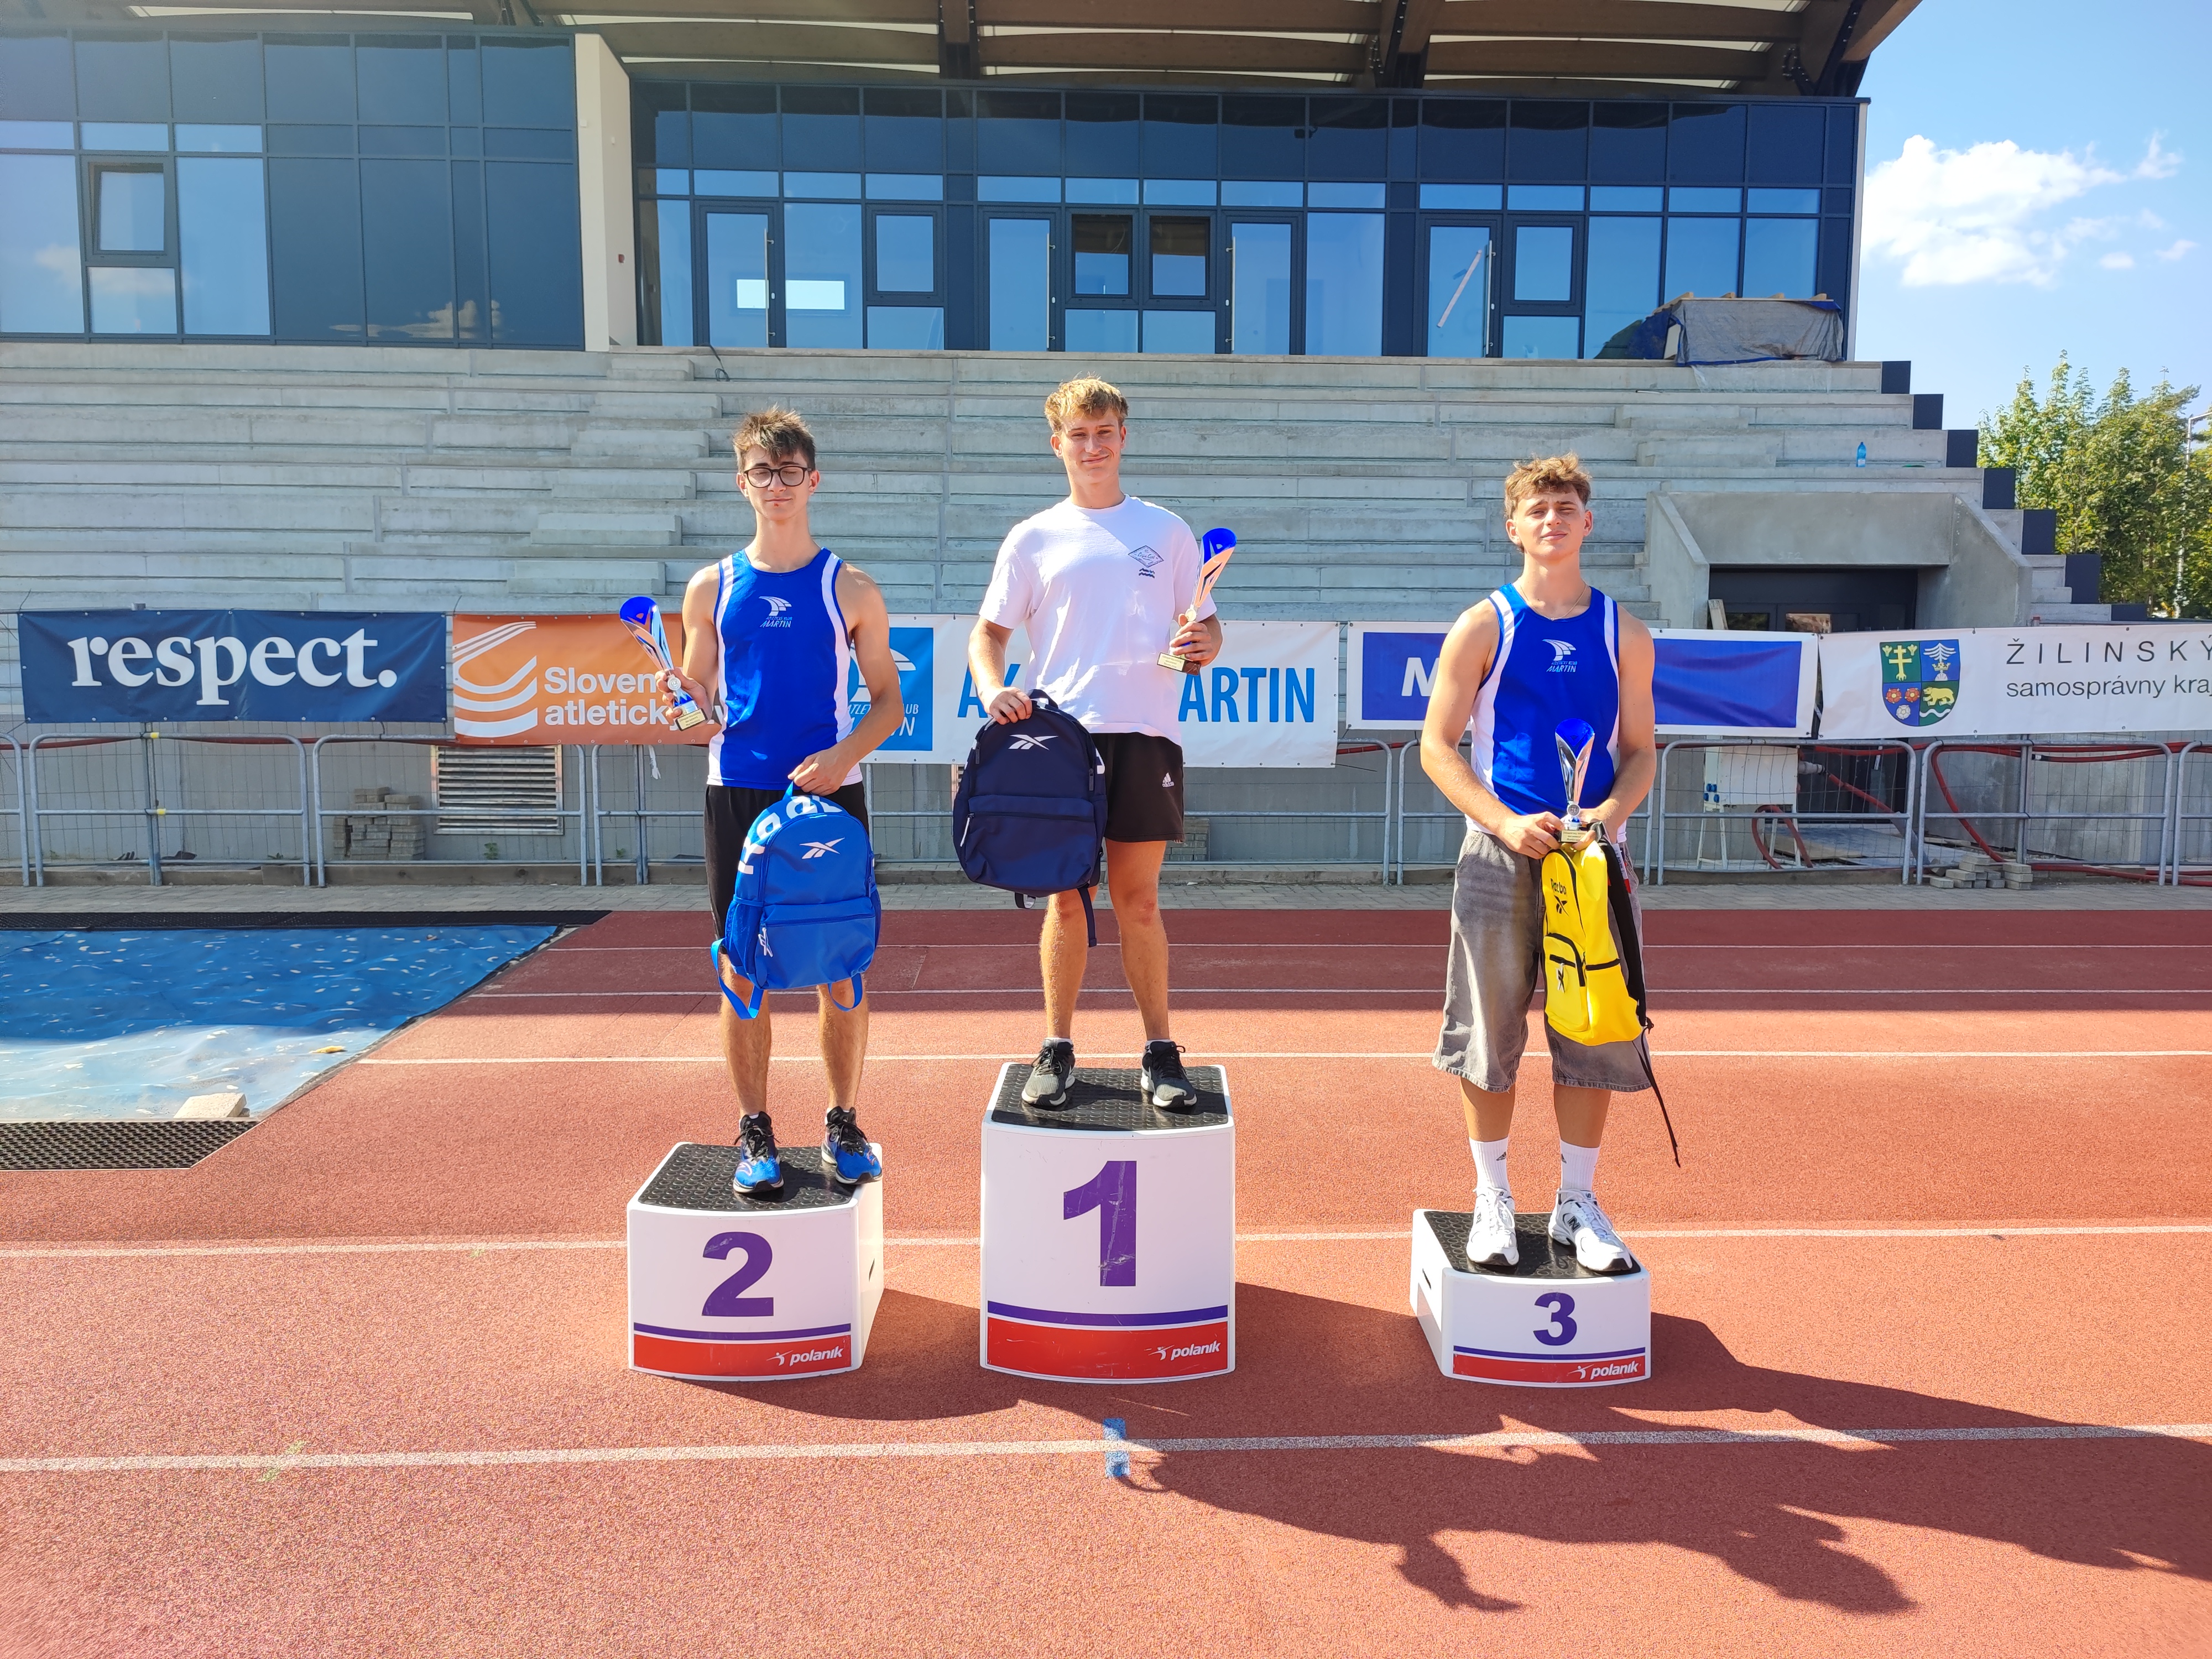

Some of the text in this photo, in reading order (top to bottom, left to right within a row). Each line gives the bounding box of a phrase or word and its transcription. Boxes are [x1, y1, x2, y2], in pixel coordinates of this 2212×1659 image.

[759, 620, 791, 628] MARTIN
[67, 628, 398, 705] respect.
[544, 666, 658, 694] Sloven
[1401, 657, 1440, 697] M
[1178, 667, 1315, 723] ARTIN
[2006, 675, 2166, 699] samosprávny
[1550, 878, 1567, 896] Reebo
[1063, 1160, 1137, 1287] 1
[701, 1232, 774, 1317] 2
[1533, 1292, 1578, 1346] 3
[789, 1346, 843, 1366] polanik
[1170, 1340, 1221, 1361] polanik
[1590, 1360, 1639, 1380] polanik
